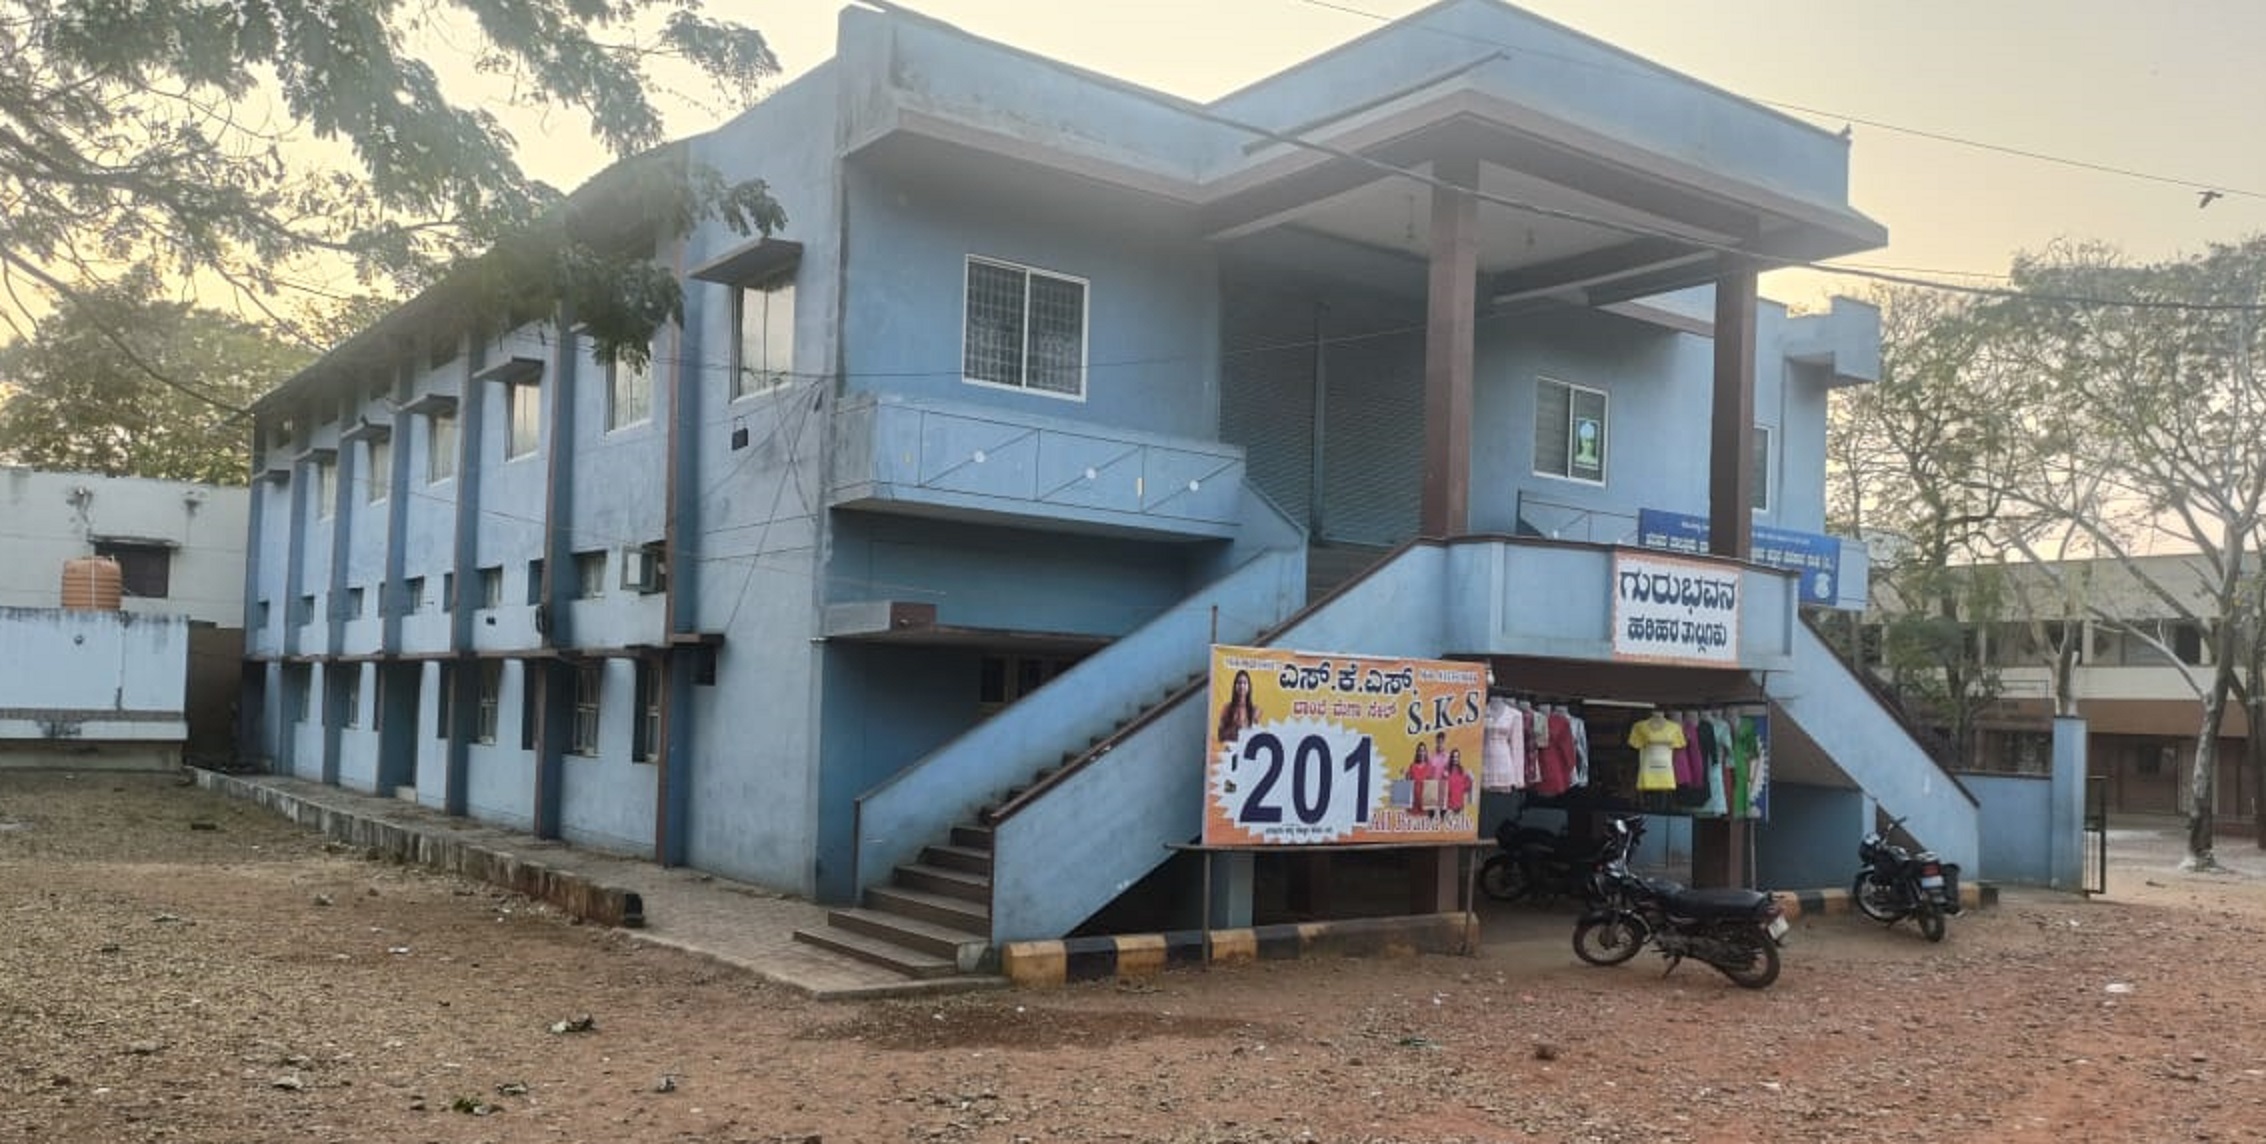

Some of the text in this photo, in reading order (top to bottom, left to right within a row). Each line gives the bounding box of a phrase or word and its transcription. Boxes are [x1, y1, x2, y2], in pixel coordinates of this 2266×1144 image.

[1619, 567, 1736, 615] ಗುರುಭವನ
[1627, 614, 1680, 643] ಹರಿಹರ
[1407, 691, 1479, 735] S.K.S
[1239, 732, 1372, 825] 201
